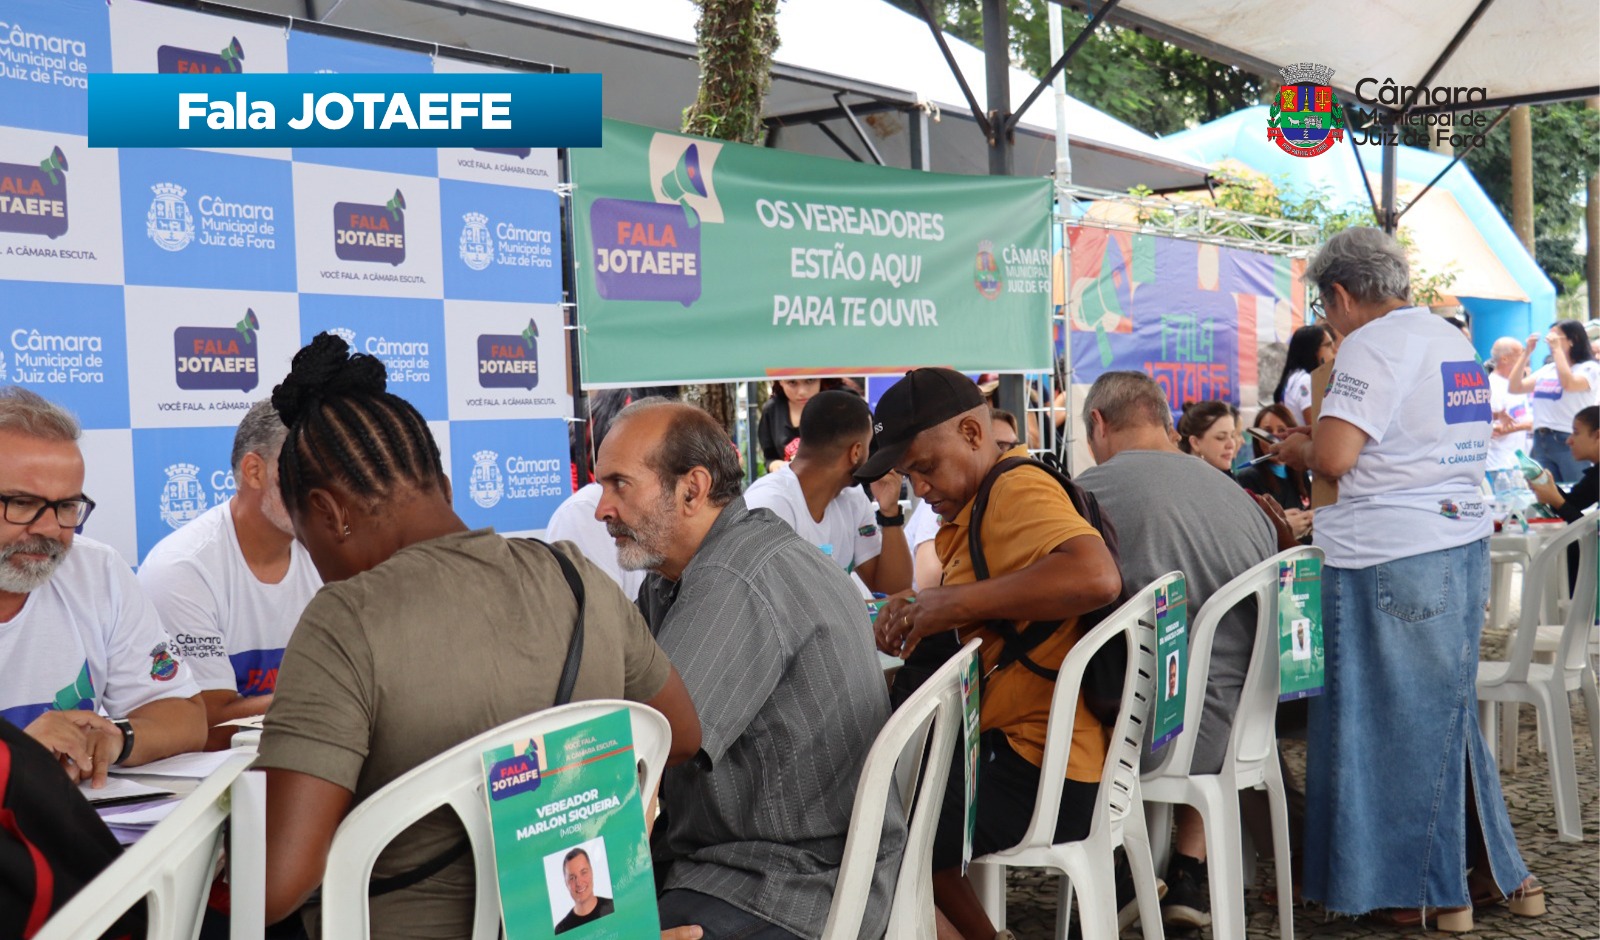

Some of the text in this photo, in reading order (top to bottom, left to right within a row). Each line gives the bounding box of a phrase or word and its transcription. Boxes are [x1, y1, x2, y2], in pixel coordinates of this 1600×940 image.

[0, 22, 86, 57] Câmara
[0, 47, 87, 73] Municipal de
[0, 61, 88, 89] Juiz de Fora
[1, 176, 46, 197] ALA
[0, 195, 65, 217] TAEFE
[198, 194, 274, 220] Câmara
[201, 217, 275, 236] Municipal de
[350, 213, 390, 231] FALA
[756, 198, 945, 241] OS VEREADORES
[199, 230, 276, 249] Juiz de Fora
[336, 229, 403, 248] JOTAEFE
[496, 222, 551, 243] Câmara
[617, 221, 678, 248] FALA
[7, 246, 14, 255] A
[16, 246, 58, 258] CÂMARA
[498, 240, 552, 256] Municipal de
[1002, 243, 1049, 265] CÂMAR
[497, 252, 552, 268] Juiz de Fora
[597, 248, 697, 276] JOTAEFE
[791, 242, 922, 288] ESTÃO AQUI
[320, 270, 340, 279] VOCÊ
[369, 272, 399, 282] CÂMARA
[1025, 280, 1037, 293] DE
[772, 295, 939, 327] PARA TE OUVIR
[11, 328, 102, 352] Câmara
[193, 338, 240, 355] FALA
[365, 336, 429, 356] Câmara
[491, 344, 525, 359] FALA
[15, 352, 103, 371] Municipal de
[177, 356, 256, 373] JOTAEFE
[383, 356, 430, 371] nicipal de
[480, 360, 536, 374] JOTAEFE
[12, 368, 104, 384] Juiz de Fora
[390, 369, 405, 382] de
[406, 370, 430, 382] Fora
[1337, 372, 1369, 390] Câmara
[1454, 371, 1484, 388] FALA
[158, 401, 181, 411] VOCÊ
[208, 402, 215, 410] A
[216, 401, 250, 410] CÂMARA
[466, 398, 482, 406] VOCÊ
[507, 397, 533, 406] CÂMARA
[1447, 389, 1491, 408] JOTAEF
[506, 455, 560, 474] Câmara
[508, 472, 561, 487] Municipal de
[507, 484, 562, 499] Juiz de Fora
[501, 761, 528, 778] FALA
[492, 768, 539, 792] JOTAEFE
[536, 788, 599, 818] VEREADOR
[516, 795, 620, 841] MARLON SIQUEIRA
[560, 823, 582, 838] (MDB)
